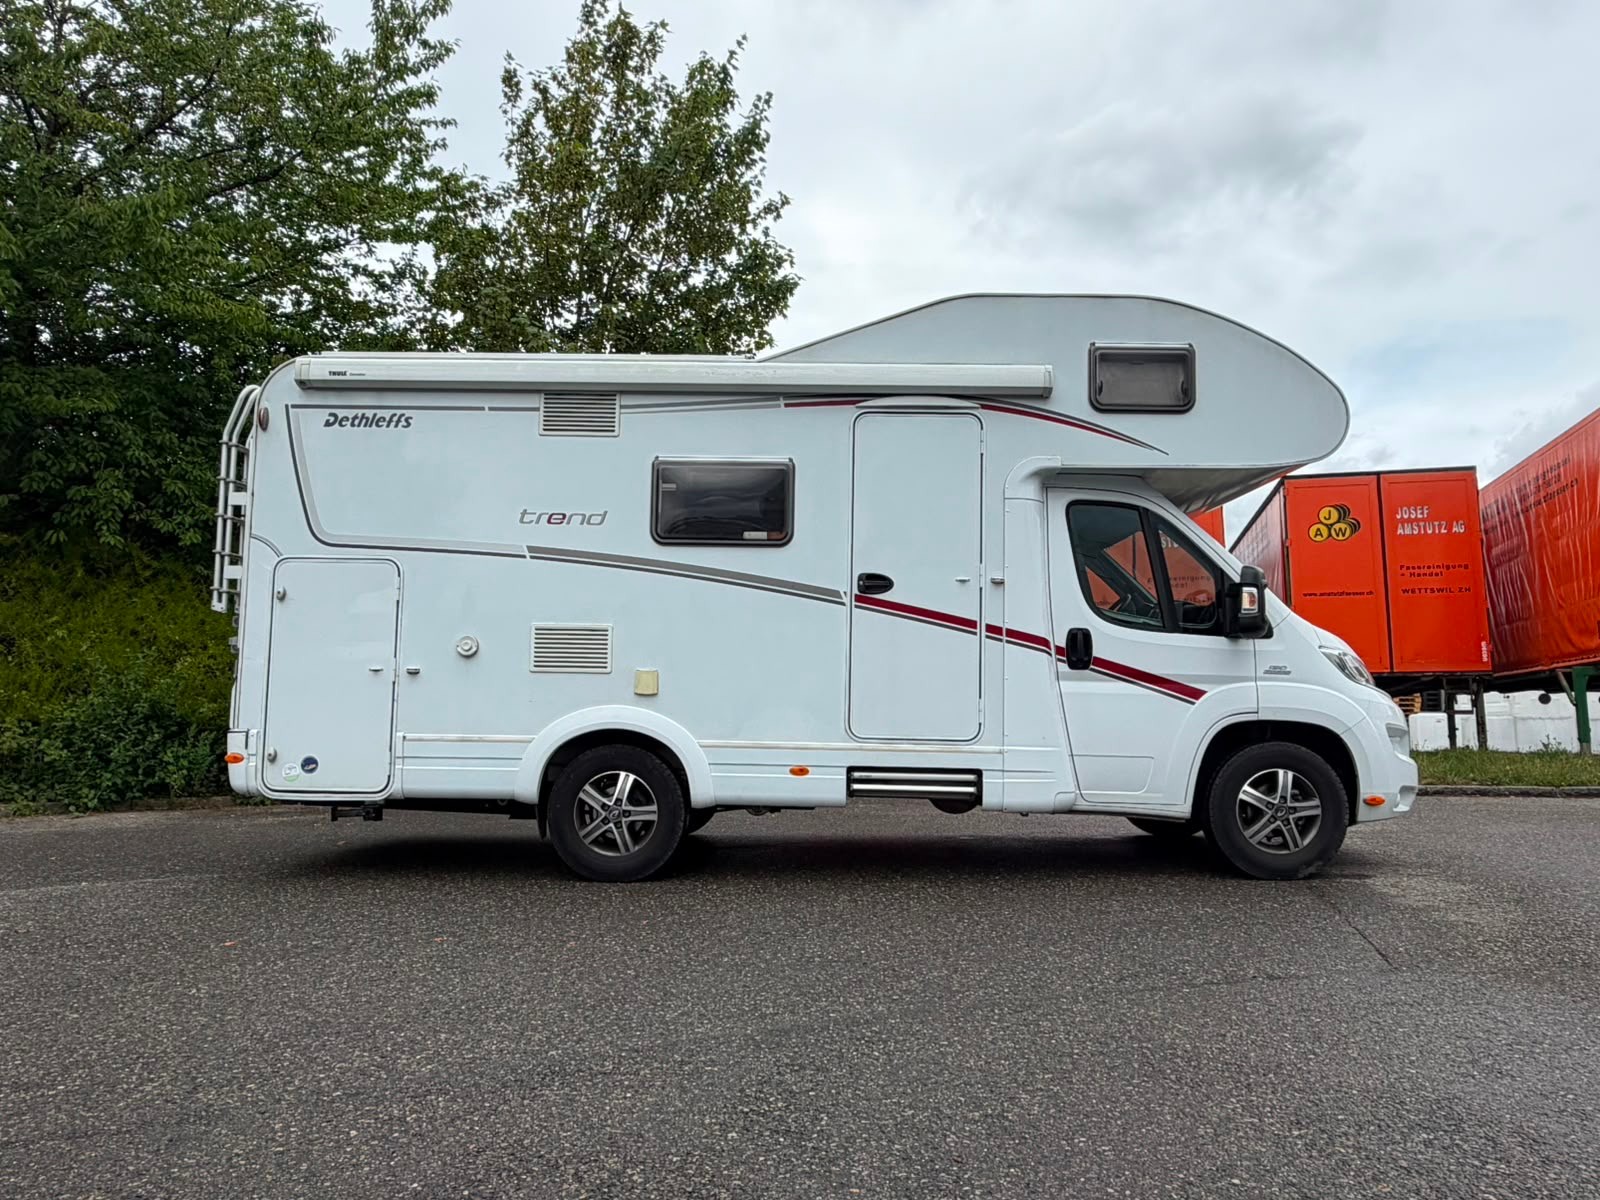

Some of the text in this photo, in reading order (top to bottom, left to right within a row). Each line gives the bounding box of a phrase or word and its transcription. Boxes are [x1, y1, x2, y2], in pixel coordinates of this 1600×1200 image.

[323, 412, 414, 428] Dethleffs
[519, 508, 608, 526] trend
[1396, 506, 1430, 519] JOSEF
[1397, 520, 1465, 535] AMSTUTZ AG
[1401, 587, 1455, 595] WETTSWIL
